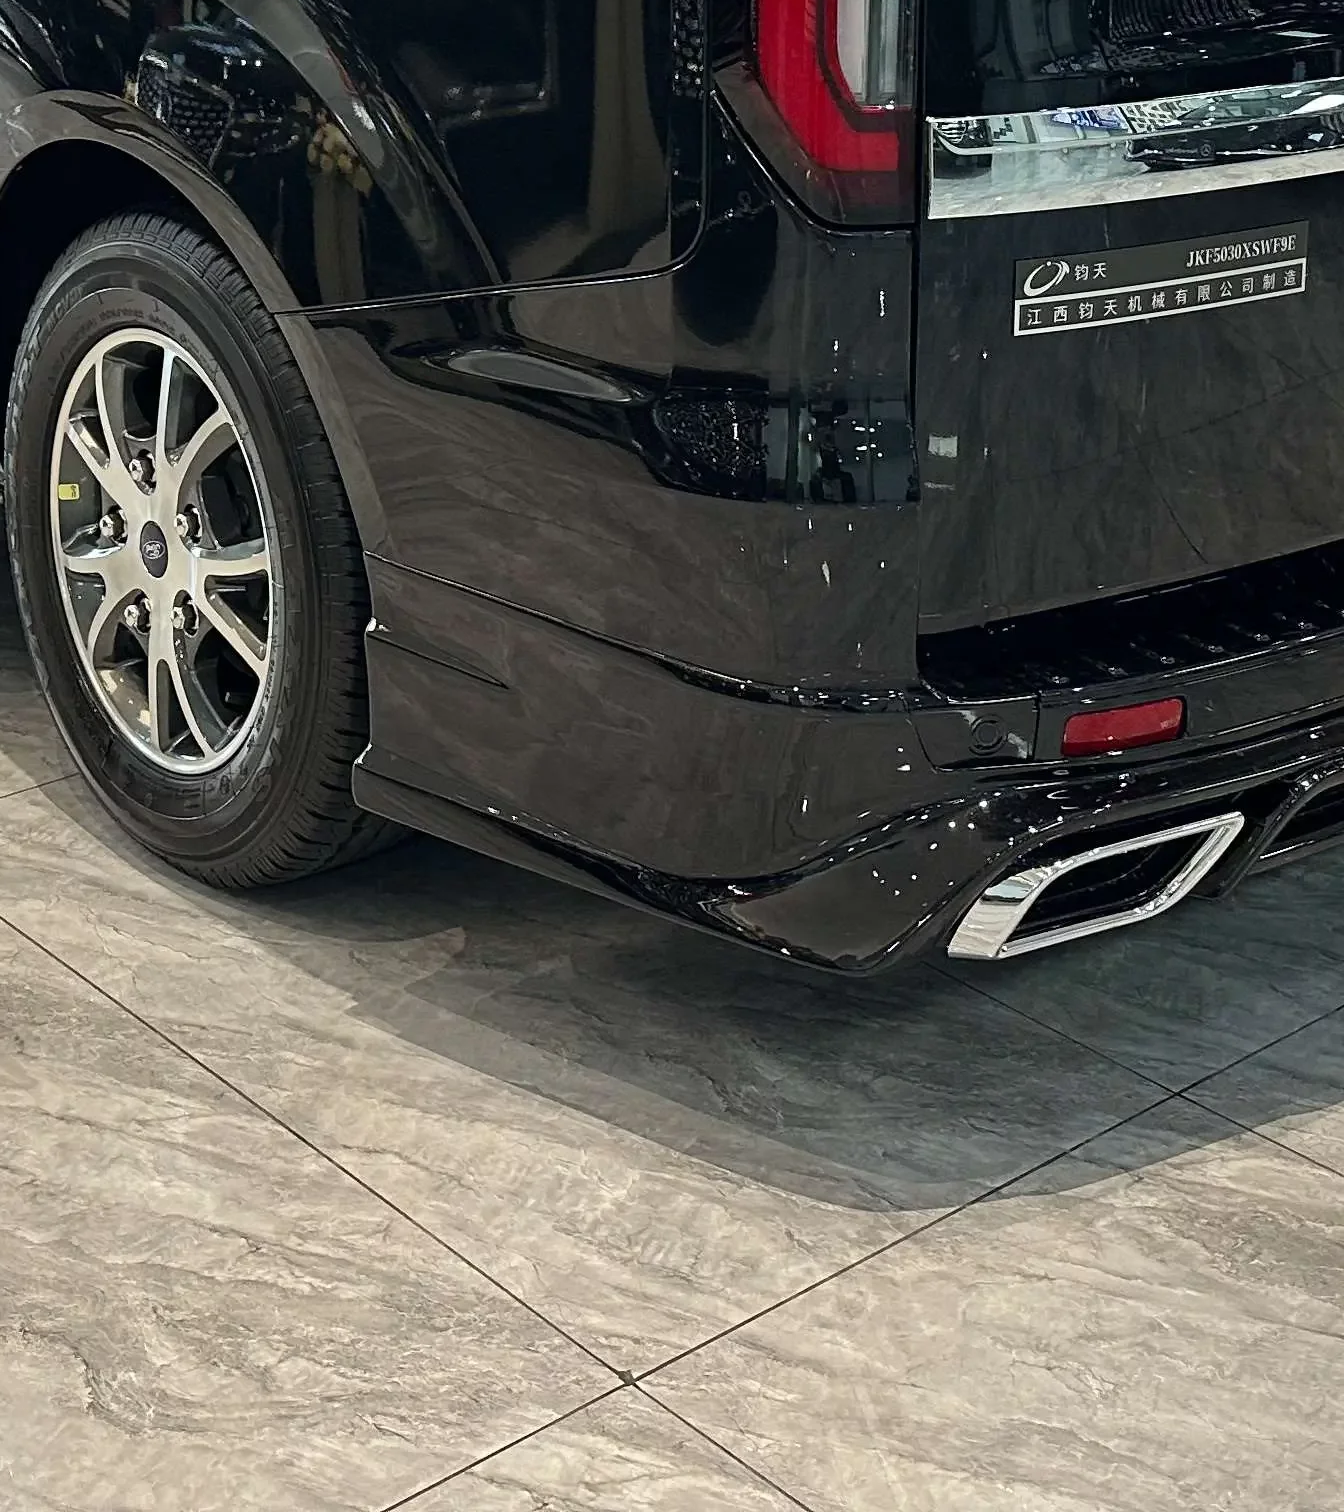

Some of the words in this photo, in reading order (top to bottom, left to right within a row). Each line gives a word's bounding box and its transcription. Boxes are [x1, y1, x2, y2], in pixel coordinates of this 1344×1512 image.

[1073, 261, 1107, 282] 钧天
[1185, 233, 1298, 269] JKF5030XSWF9E
[1026, 269, 1299, 327] 江西钧天机械有限公司制造
